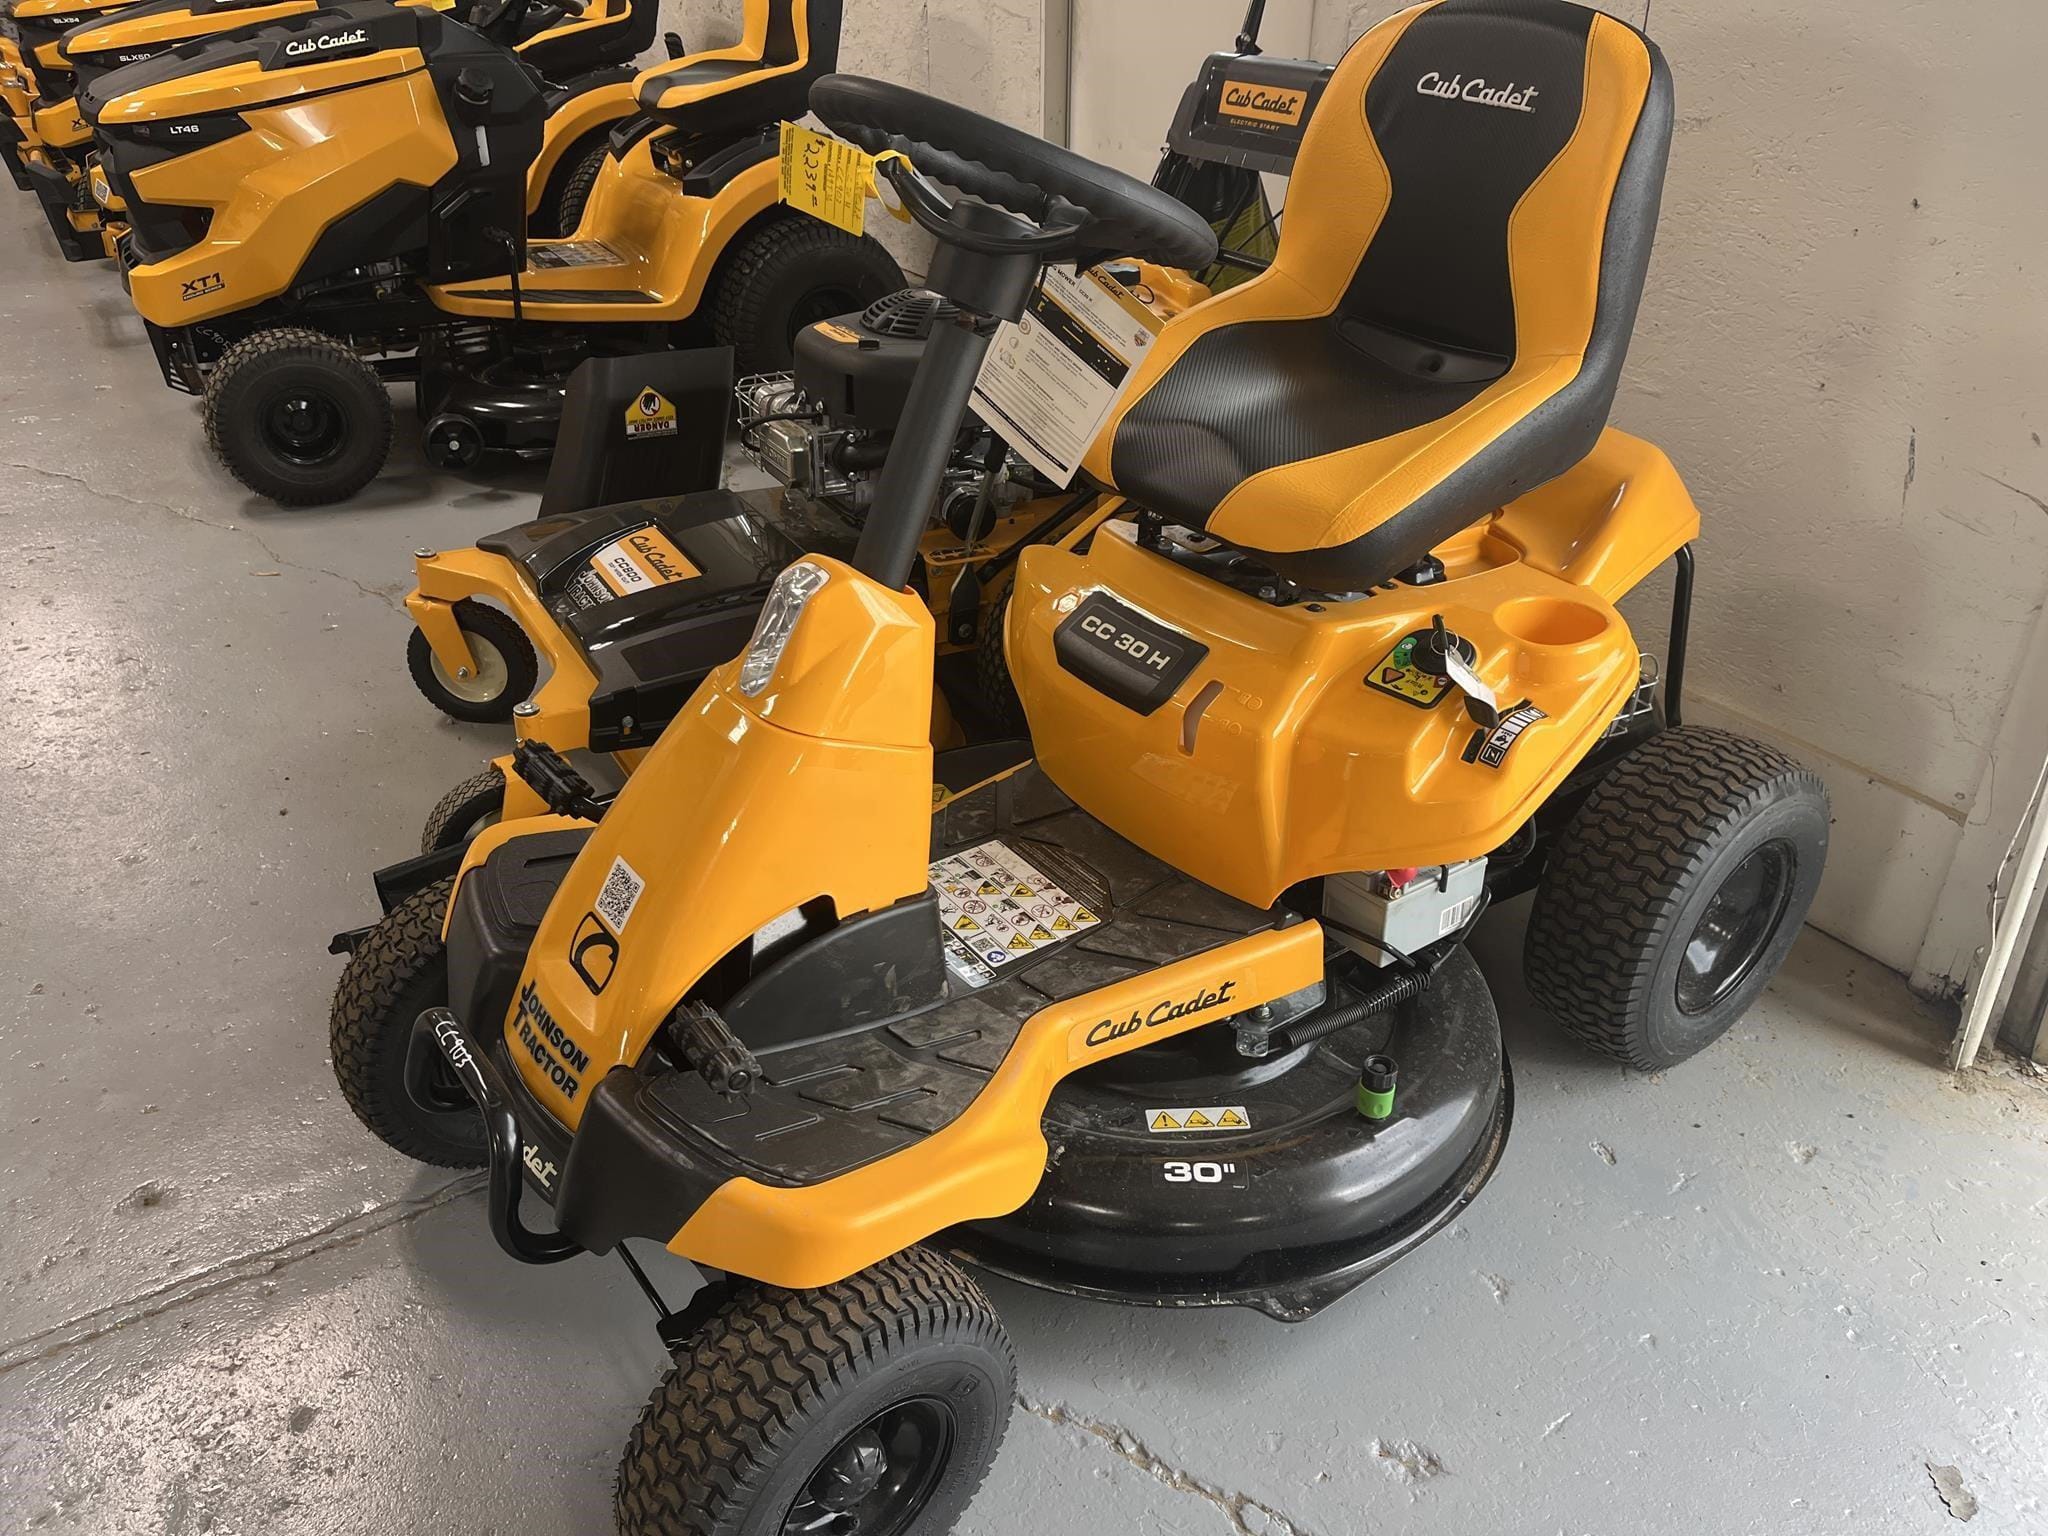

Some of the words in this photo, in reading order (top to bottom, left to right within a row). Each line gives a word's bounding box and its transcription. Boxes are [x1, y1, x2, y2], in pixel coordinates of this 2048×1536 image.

[285, 40, 317, 56] Cub
[317, 29, 367, 51] Cadet
[1226, 88, 1251, 107] Cub
[1251, 91, 1298, 115] Cadet
[1416, 72, 1461, 100] Cub
[1462, 79, 1539, 112] Cadet
[169, 124, 200, 135] LT46
[1230, 118, 1258, 128] ELECTRIC
[1259, 123, 1280, 132] START
[181, 272, 221, 295] XT1
[1058, 270, 1076, 287] MOWER
[1088, 269, 1099, 278] ub
[1098, 275, 1125, 300] Cadet
[634, 421, 670, 432] DANGER
[629, 535, 652, 555] Cub
[646, 552, 685, 581] Cadet
[1080, 615, 1117, 641] CC
[1114, 633, 1149, 658] 30
[1149, 650, 1170, 671] H
[521, 979, 590, 1075] JOHNSON
[1086, 1010, 1142, 1047] Cub
[1144, 981, 1236, 1027] Cadet
[433, 1020, 473, 1069] CC903
[511, 1001, 580, 1100] TRACTOR
[523, 1144, 558, 1188] det
[1163, 1161, 1236, 1183] 30"
